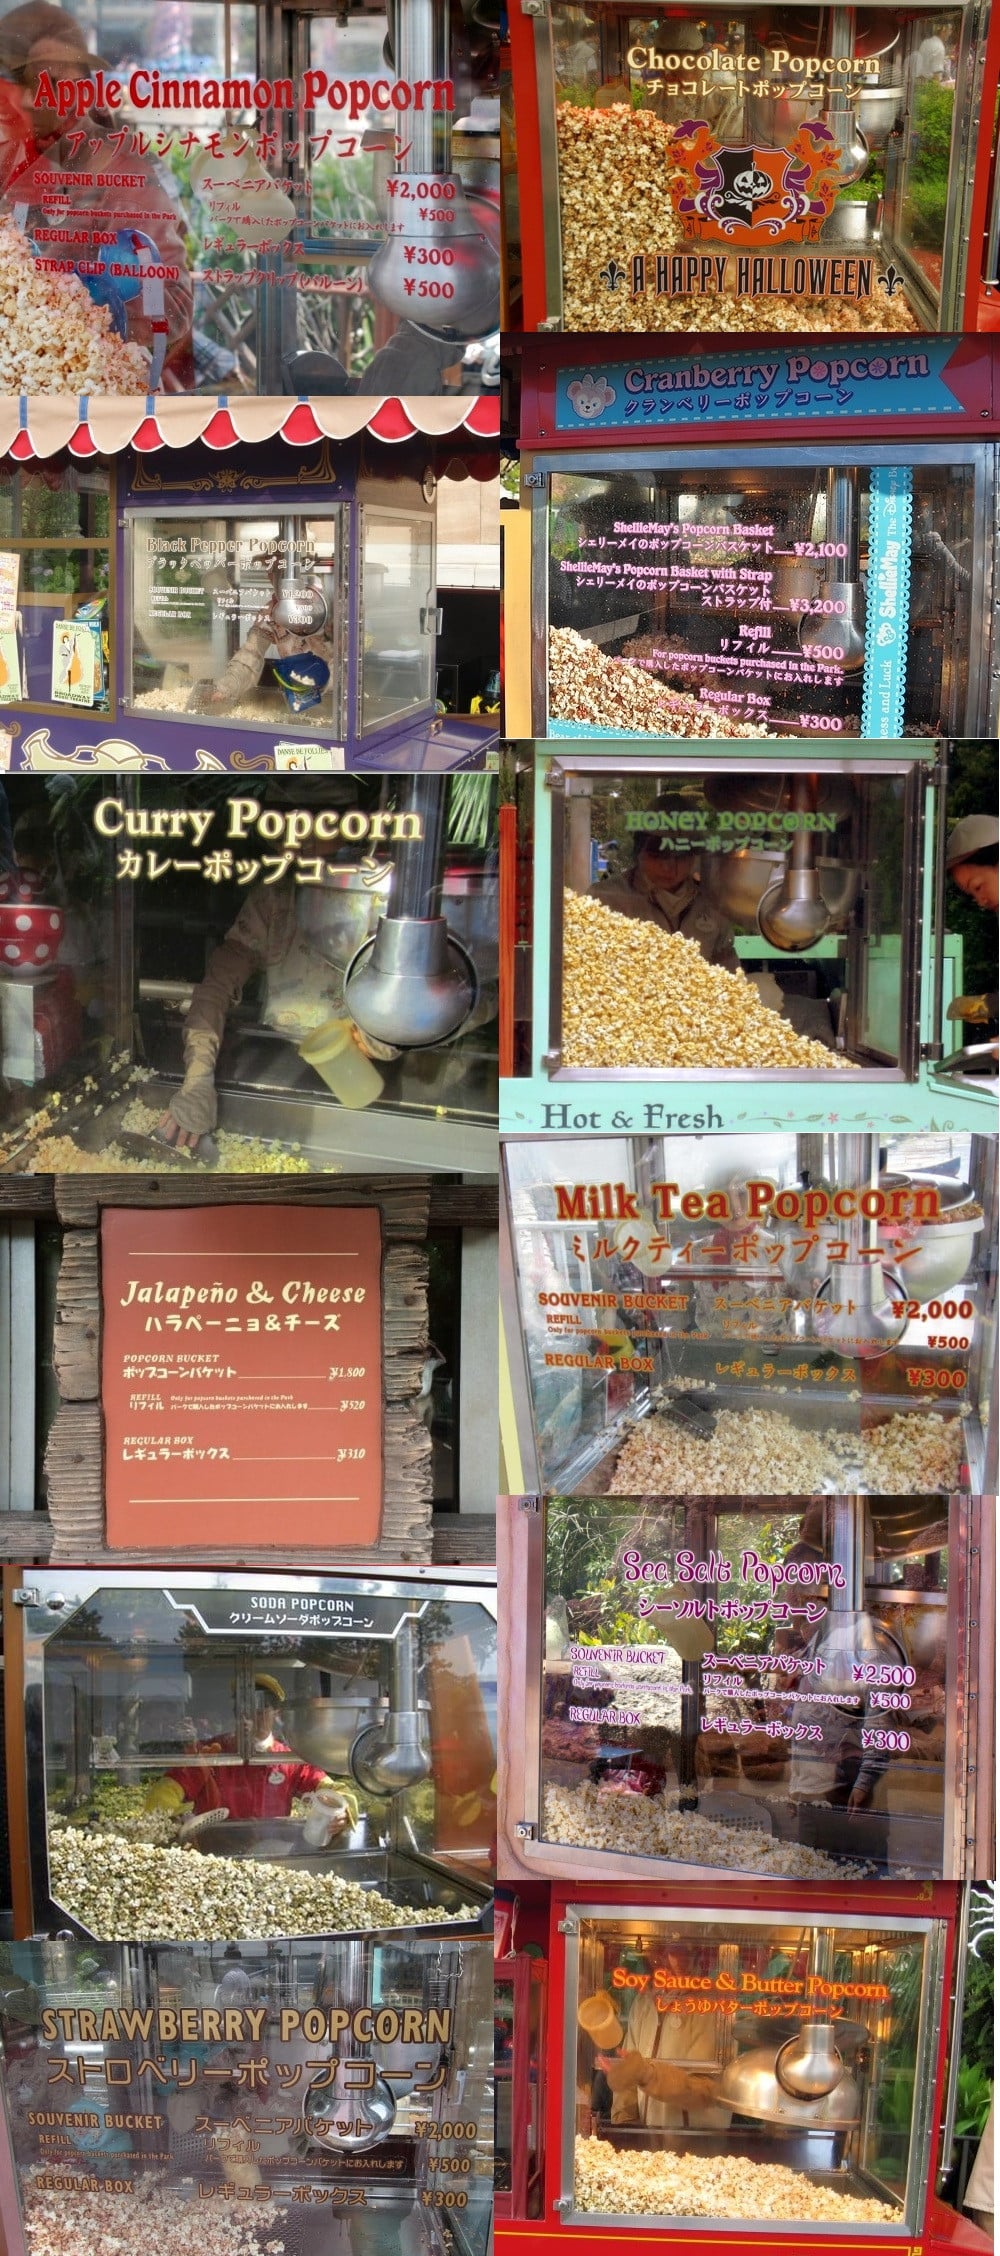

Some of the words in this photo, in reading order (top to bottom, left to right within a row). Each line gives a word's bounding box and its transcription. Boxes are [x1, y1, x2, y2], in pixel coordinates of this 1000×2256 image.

[627, 46, 761, 74] Chocolate
[771, 51, 881, 81] Popcorn
[34, 70, 121, 117] Apple
[129, 70, 294, 111] Cinnamon
[303, 70, 456, 120] Popcorn
[646, 78, 863, 100] チョコレートポップコーン
[67, 130, 413, 163] アップルシナモンポップコーン
[34, 172, 93, 186] SOUVENIR
[97, 174, 145, 188] BUCKET
[387, 179, 456, 201] ¥2,000
[42, 195, 71, 205] REFILL
[208, 201, 241, 212] リフィル
[113, 211, 142, 219] purchased
[419, 207, 455, 222] ¥500
[34, 229, 89, 243] REGULAR
[93, 231, 117, 245] BOX
[203, 238, 304, 256] レギュラーボックス
[403, 246, 455, 266] ¥300
[35, 258, 74, 272] STRAP
[78, 261, 106, 274] CLIP
[110, 263, 179, 280] (BALLOON)
[632, 256, 645, 295] A
[654, 255, 727, 298] HAPPY
[736, 255, 873, 301] HALLOWEEN
[403, 278, 455, 299] ¥500
[624, 360, 780, 400] Cranberry
[787, 352, 930, 386] Popcorn
[624, 388, 854, 417] クランベリーポップコーン
[881, 480, 900, 516] Disney
[613, 521, 680, 537] ShellieMay's
[682, 523, 731, 538] Popcorn
[733, 524, 774, 537] Basket
[886, 517, 898, 536] The
[147, 537, 186, 553] Black
[190, 537, 243, 554] Pepper
[249, 538, 315, 555] Popcorn
[794, 542, 848, 558] ¥2,100
[560, 560, 622, 576] ShellieMay's
[623, 563, 668, 578] Popcorn
[670, 565, 710, 579] Basket
[712, 567, 736, 580] with
[739, 568, 773, 583] Strap
[878, 540, 901, 618] ShellieMay
[700, 596, 773, 612] ストラップ付
[790, 598, 846, 615] ¥3,200
[739, 624, 771, 640] Refill
[720, 638, 770, 655] リフィル
[802, 645, 844, 661] ¥500
[652, 648, 668, 659] For
[669, 650, 703, 662] popcorn
[704, 653, 739, 666] buckets
[740, 657, 787, 671] purchased
[788, 660, 798, 671] in
[799, 661, 816, 672] the
[817, 663, 844, 675] Park.
[878, 659, 892, 689] Luck
[700, 688, 745, 704] Regular
[746, 693, 772, 706] Box
[879, 691, 891, 714] and
[799, 715, 843, 732] ¥300
[94, 798, 214, 845] Curry
[228, 799, 423, 847] Popcorn
[717, 811, 837, 832] POPCORN
[659, 836, 794, 853] ハニーポップコーン
[116, 850, 395, 887] カレーポップコーン
[541, 1104, 601, 1129] Hot
[611, 1111, 634, 1129] &
[643, 1103, 725, 1130] Fresh
[555, 1183, 639, 1220] Milk
[652, 1184, 730, 1219] Tea
[747, 1182, 942, 1228] Popcorn
[572, 1235, 924, 1265] ミルクティーポップコーン
[120, 1280, 238, 1309] Jalapeño
[245, 1281, 274, 1304] &
[281, 1281, 367, 1304] Cheese
[538, 1292, 617, 1309] SOUVENIR
[623, 1295, 688, 1310] BUCKET
[546, 1314, 582, 1325] REFILL
[891, 1300, 974, 1322] ¥2,000
[144, 1313, 342, 1332] ハラペーニョ&チーズ
[927, 1335, 969, 1350] ¥500
[123, 1354, 174, 1363] POPCORN
[176, 1354, 220, 1363] BUCKET
[545, 1353, 616, 1370] REGULAR
[620, 1357, 655, 1371] BOX
[122, 1366, 237, 1379] ポップコーンバケット
[714, 1362, 857, 1382] レギュラーボックス
[906, 1368, 967, 1389] ¥300
[129, 1401, 164, 1411] リフィル
[130, 1393, 162, 1401] REFILL
[123, 1437, 171, 1445] REGULAR
[173, 1437, 194, 1445] BOX
[122, 1447, 230, 1461] レギュラーボックス
[336, 1448, 366, 1462] ¥310
[623, 1550, 668, 1584] Sea
[674, 1551, 731, 1585] Salt
[740, 1552, 847, 1595] Popcorn
[250, 1596, 286, 1609] SODA
[291, 1598, 354, 1612] POPCORN
[638, 1598, 827, 1624] シーソルトポップコーン
[229, 1612, 374, 1628] クリームソーダポップコーン
[570, 1647, 623, 1662] SOUVENIR
[626, 1649, 667, 1664] BUCKET
[702, 1653, 826, 1675] スーベニアバケット
[573, 1666, 601, 1679] REFILL
[702, 1673, 743, 1686] リフィル
[870, 1692, 911, 1709] ¥500
[569, 1706, 617, 1723] REGULAR
[618, 1711, 642, 1725] BOX
[700, 1717, 823, 1740] レギュラーボックス
[862, 1729, 910, 1751] ¥300
[611, 1968, 649, 1991] Soy
[654, 1970, 711, 1990] Sauce
[715, 1972, 736, 1991] &
[741, 1973, 804, 1994] Butter
[807, 1976, 888, 1999] Popcorn
[656, 1997, 843, 2018] しょうゆバターポップコーン
[41, 2007, 267, 2043] STRAWBERRY
[280, 2008, 451, 2044] POPCORN
[47, 2056, 447, 2092] ストロベリーポップコーン
[28, 2112, 100, 2128] SOUVENIR
[104, 2114, 162, 2130] BUCKET
[195, 2115, 373, 2137] スーベニアバケット
[39, 2134, 72, 2145] REFILL
[414, 2122, 477, 2142] ¥2,000
[203, 2139, 260, 2152] リフィル
[428, 2158, 471, 2174] ¥500
[36, 2175, 100, 2193] REGULAR
[104, 2179, 134, 2194] BOX
[199, 2183, 367, 2206] レギュラーボックス
[422, 2191, 468, 2209] ¥300
